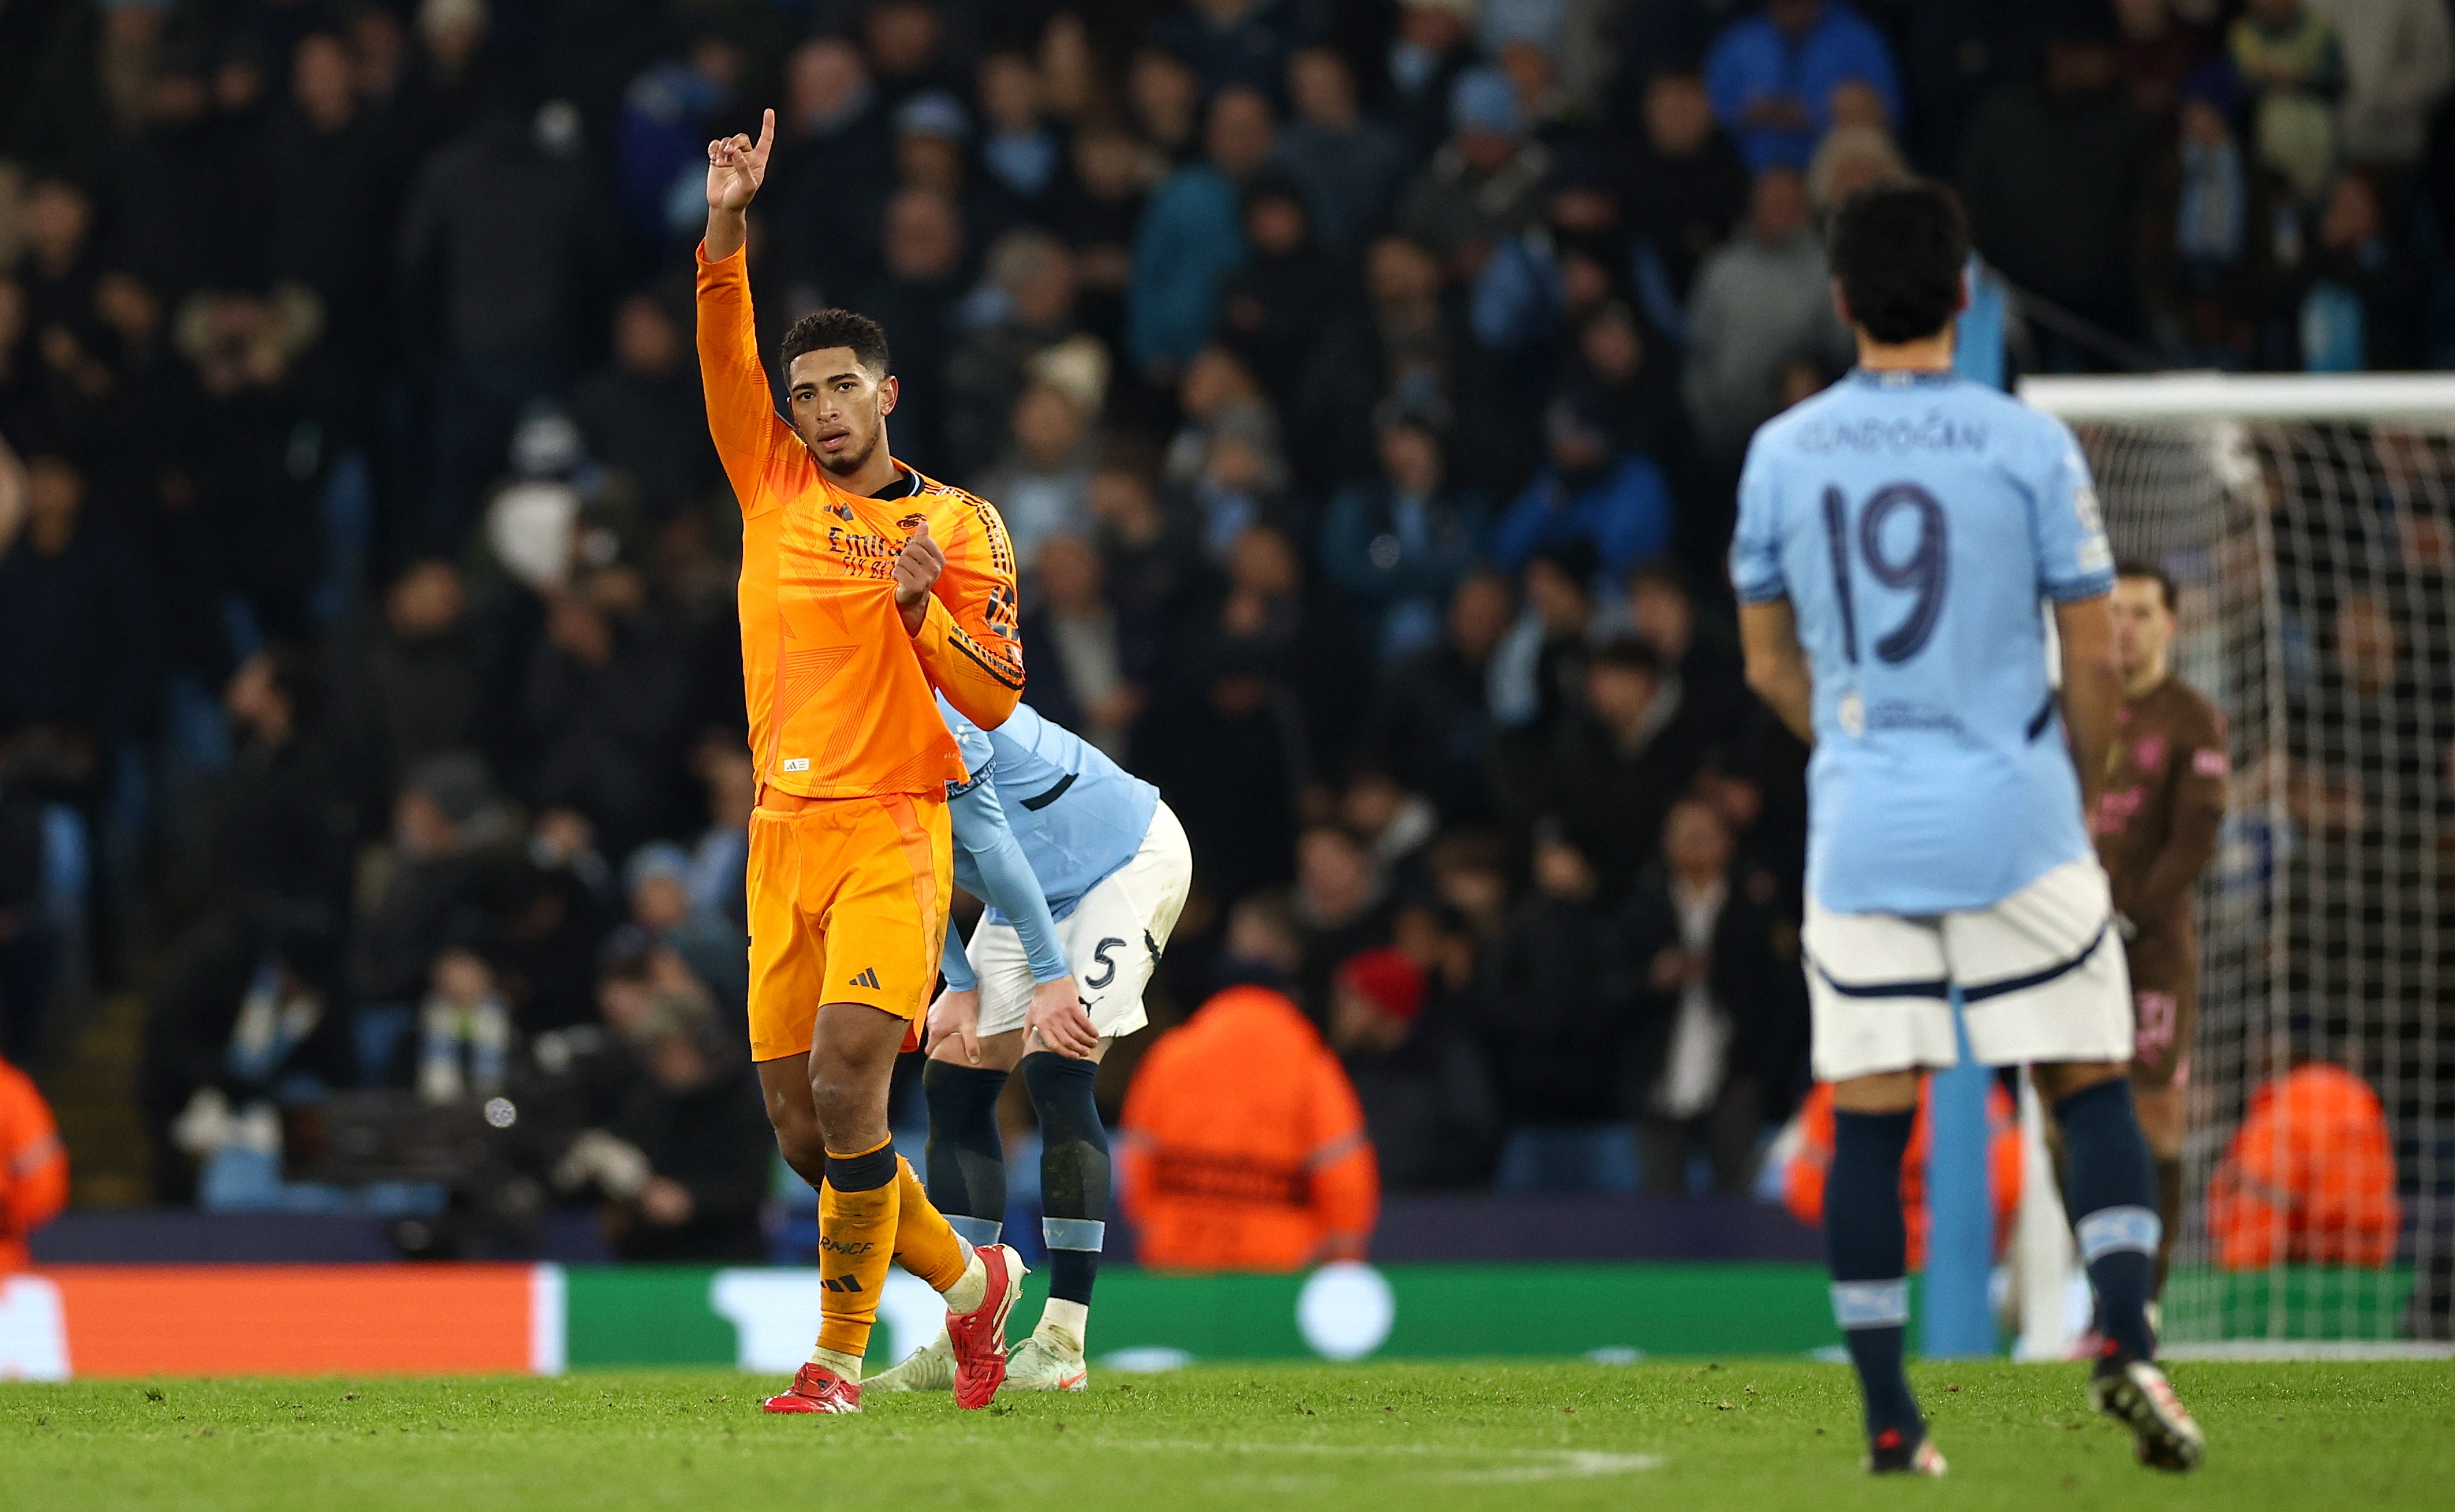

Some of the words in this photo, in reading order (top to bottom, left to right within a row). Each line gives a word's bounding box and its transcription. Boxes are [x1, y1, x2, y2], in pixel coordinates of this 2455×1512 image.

[829, 527, 914, 557] Emira
[1820, 479, 1950, 668] 19
[1085, 937, 1127, 990] 5
[820, 1235, 874, 1255] RMCF
